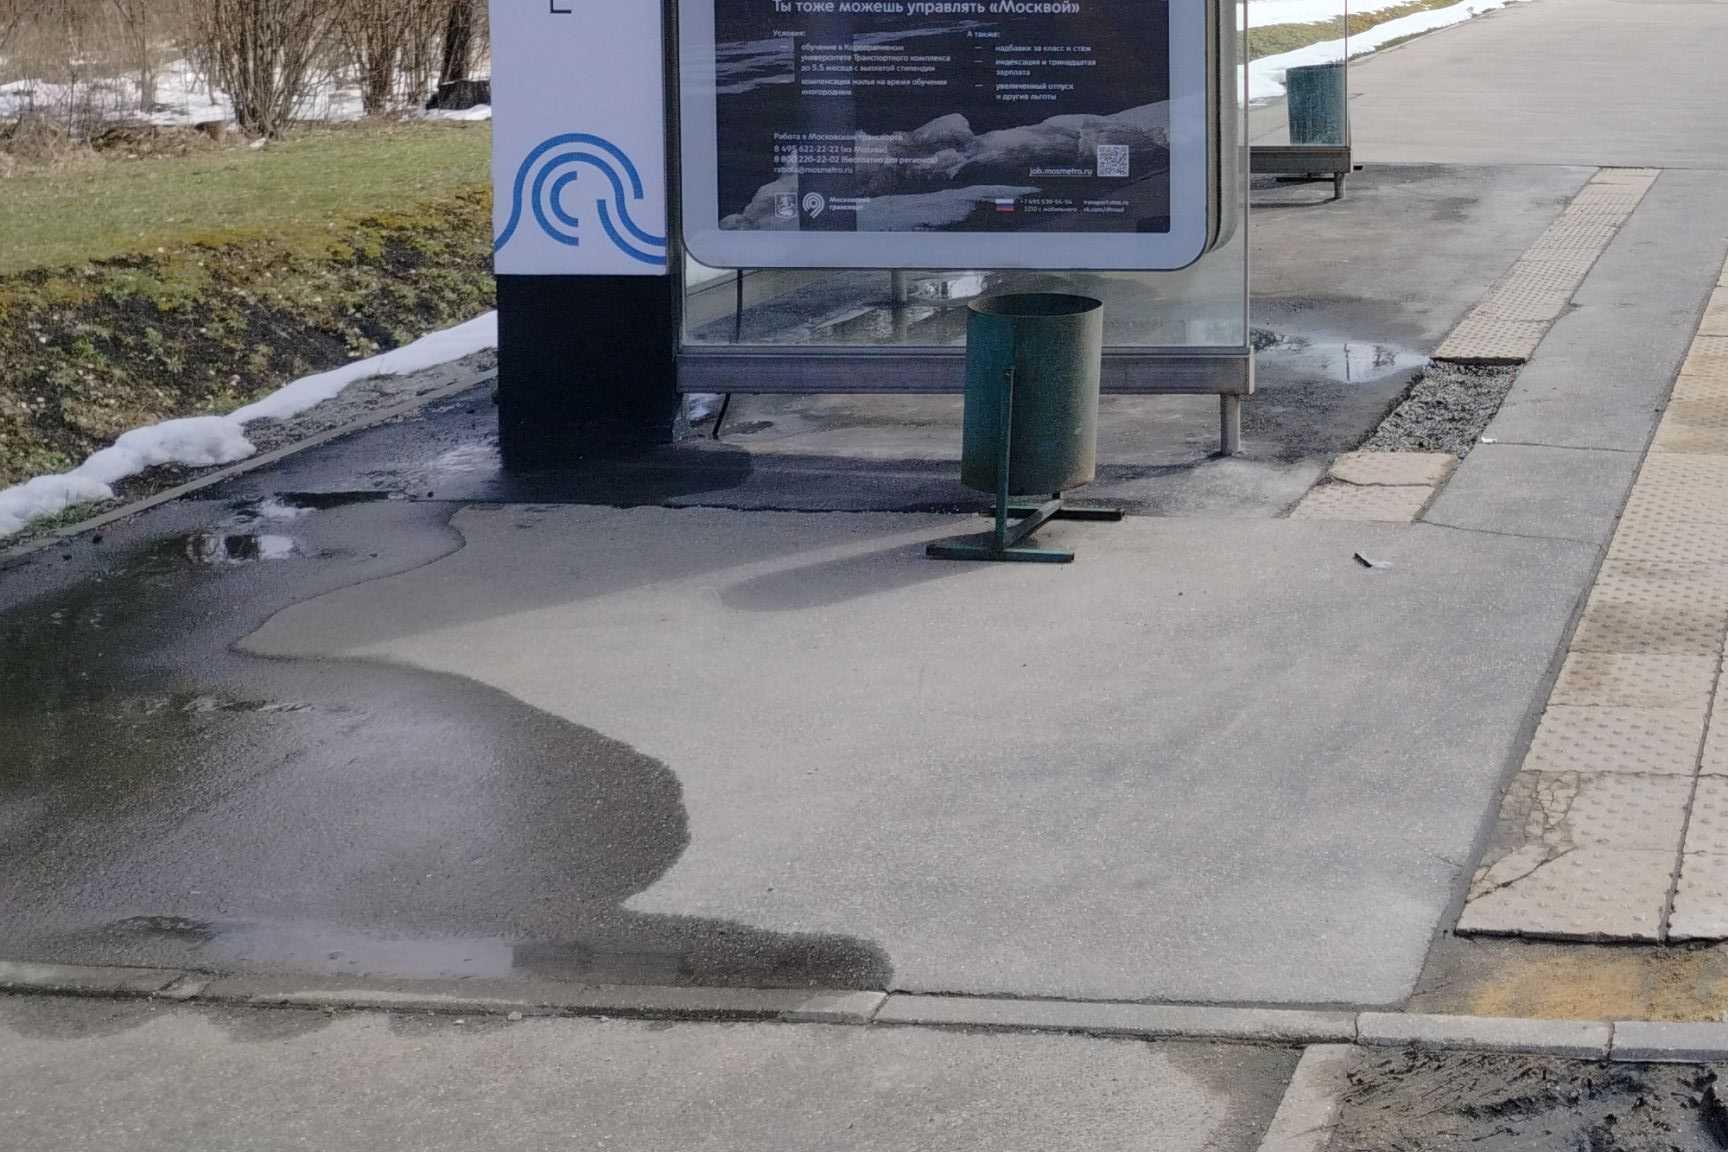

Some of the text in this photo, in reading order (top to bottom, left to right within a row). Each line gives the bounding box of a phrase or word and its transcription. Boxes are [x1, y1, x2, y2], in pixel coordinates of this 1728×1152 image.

[772, 0, 1080, 16] Ты тоже можешь управлять «Москвой»
